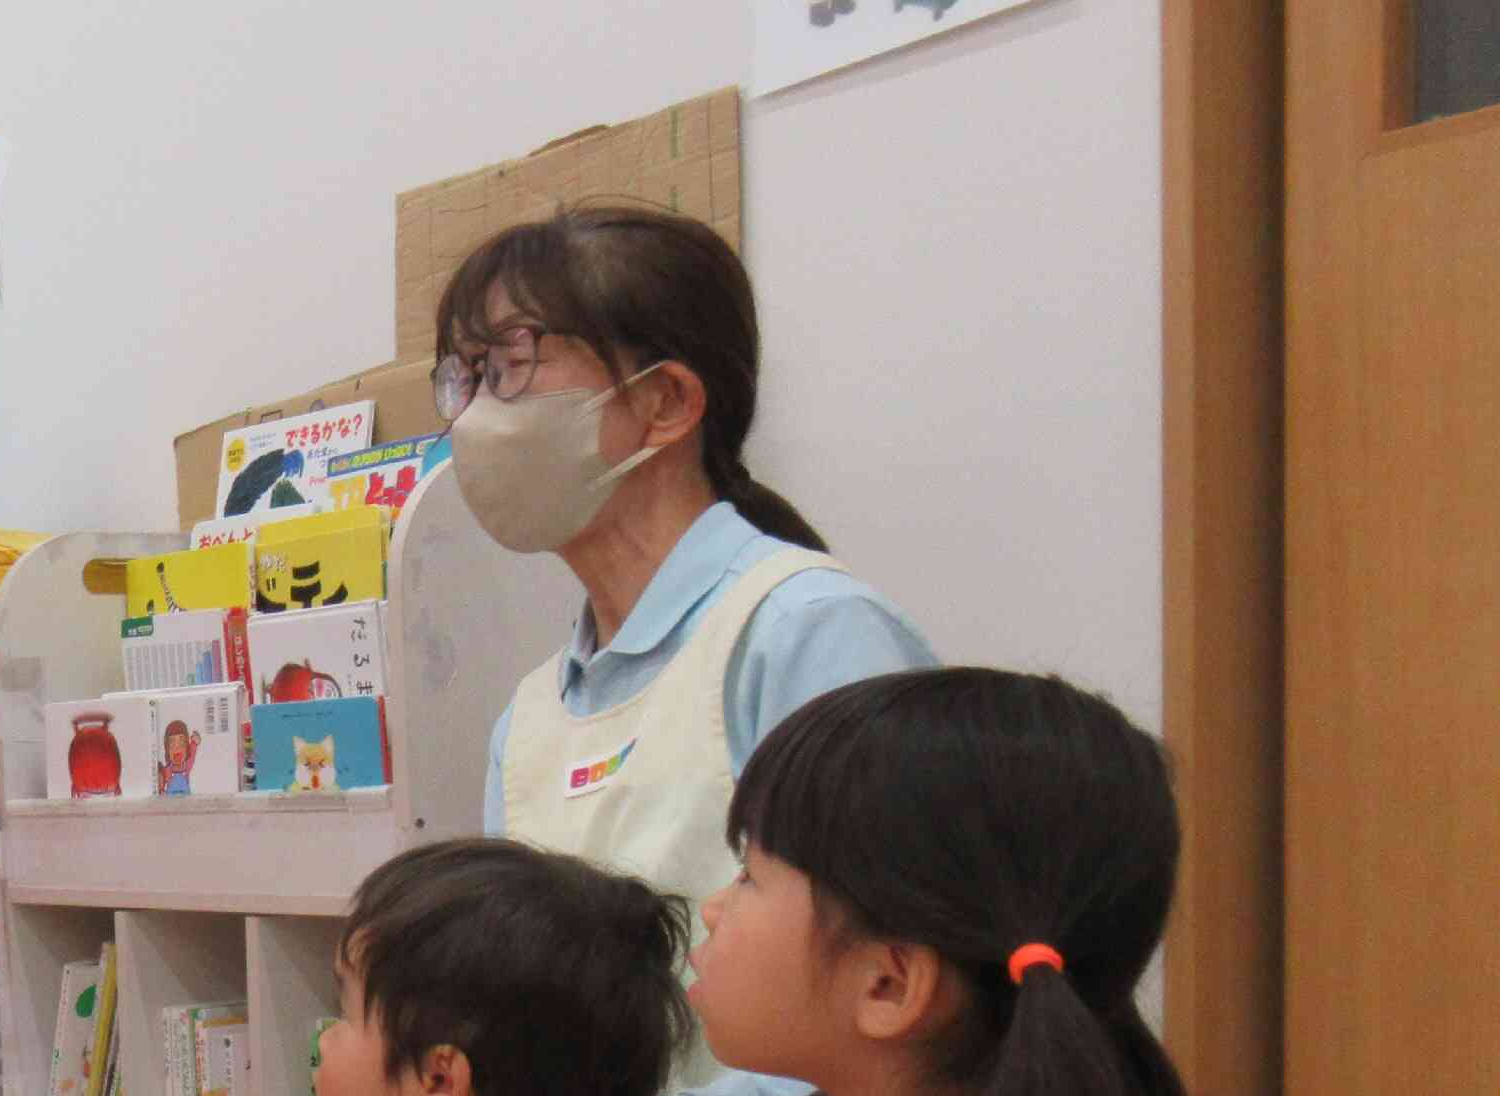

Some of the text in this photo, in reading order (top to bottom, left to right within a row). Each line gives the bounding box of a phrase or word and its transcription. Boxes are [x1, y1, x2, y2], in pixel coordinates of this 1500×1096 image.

[285, 412, 363, 448] できるかな?
